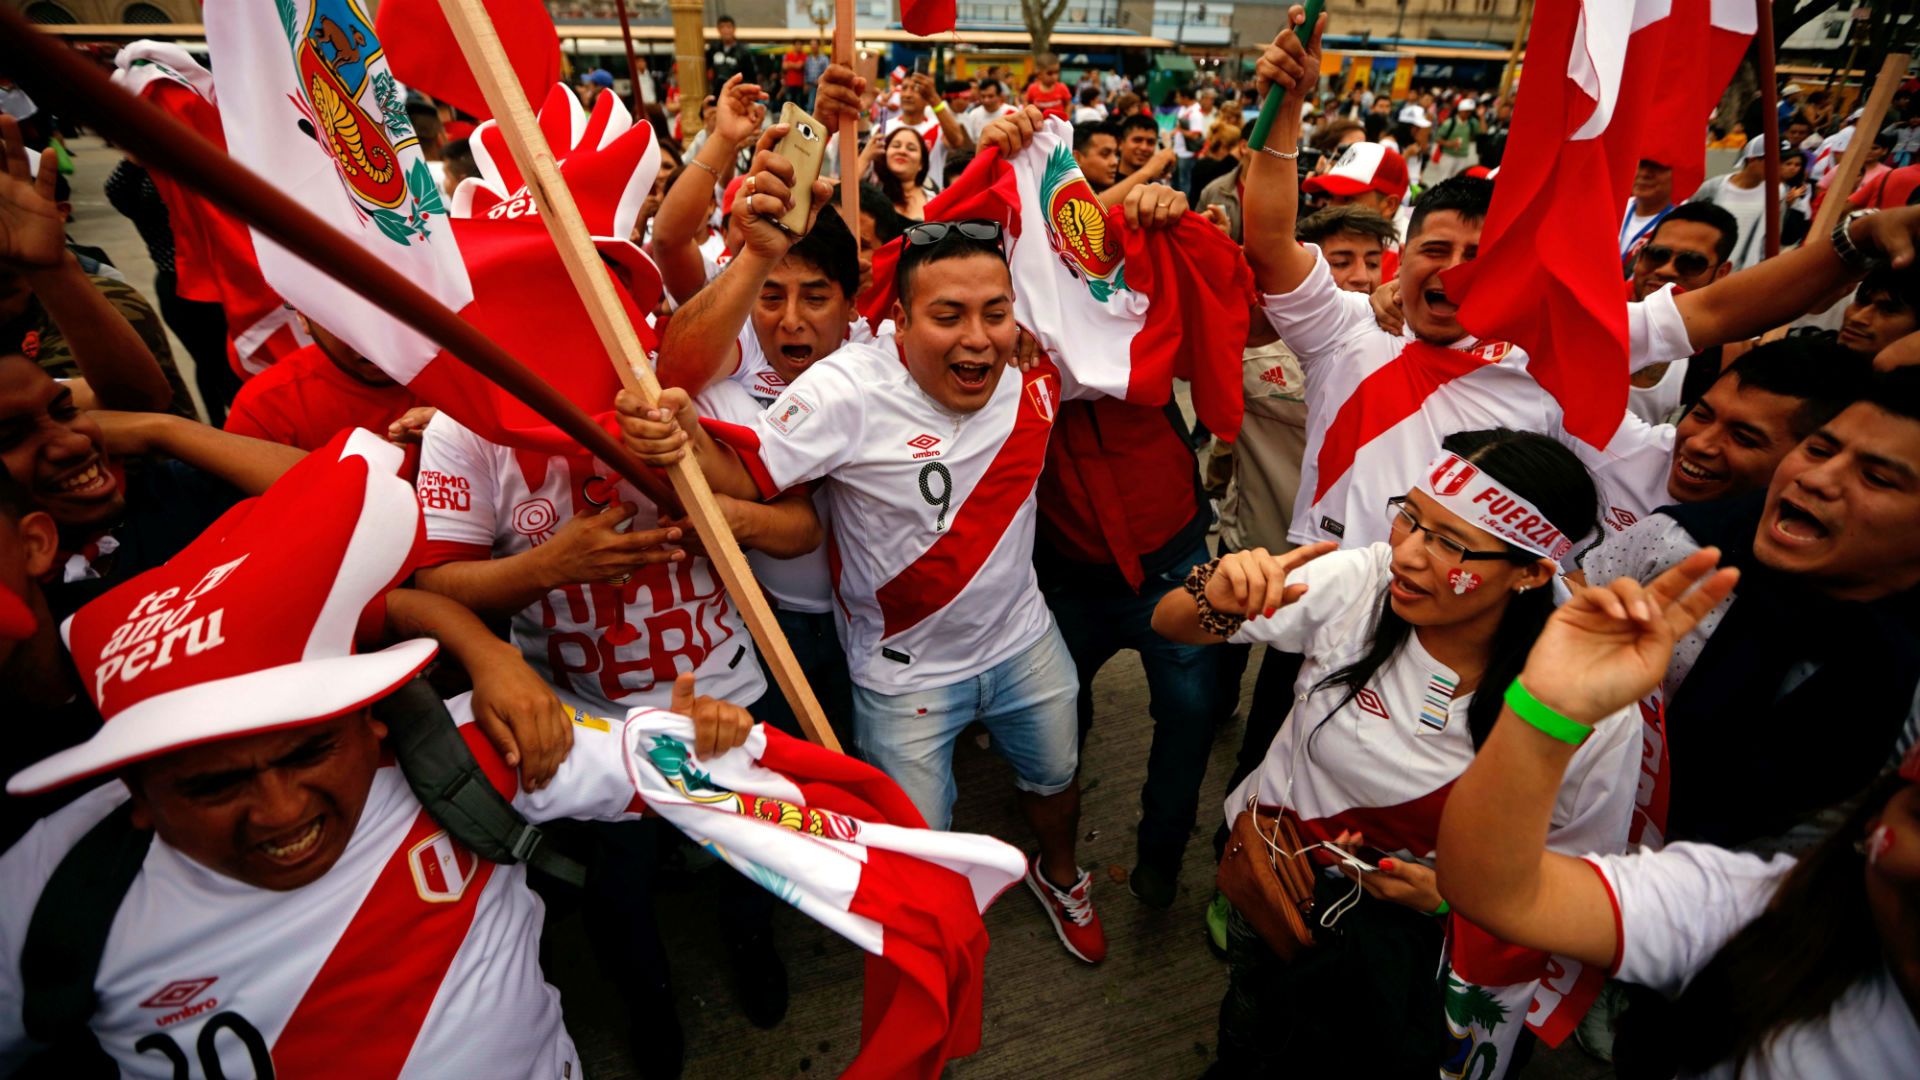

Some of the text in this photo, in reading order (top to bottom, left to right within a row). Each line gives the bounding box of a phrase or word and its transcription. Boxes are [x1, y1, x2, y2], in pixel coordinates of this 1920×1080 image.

[912, 449, 941, 459] umbro
[918, 461, 953, 532] 9
[1472, 486, 1562, 549] FUERZA
[100, 599, 197, 661] amo
[127, 586, 181, 621] te
[94, 607, 226, 710] peru
[156, 997, 218, 1027] umbro
